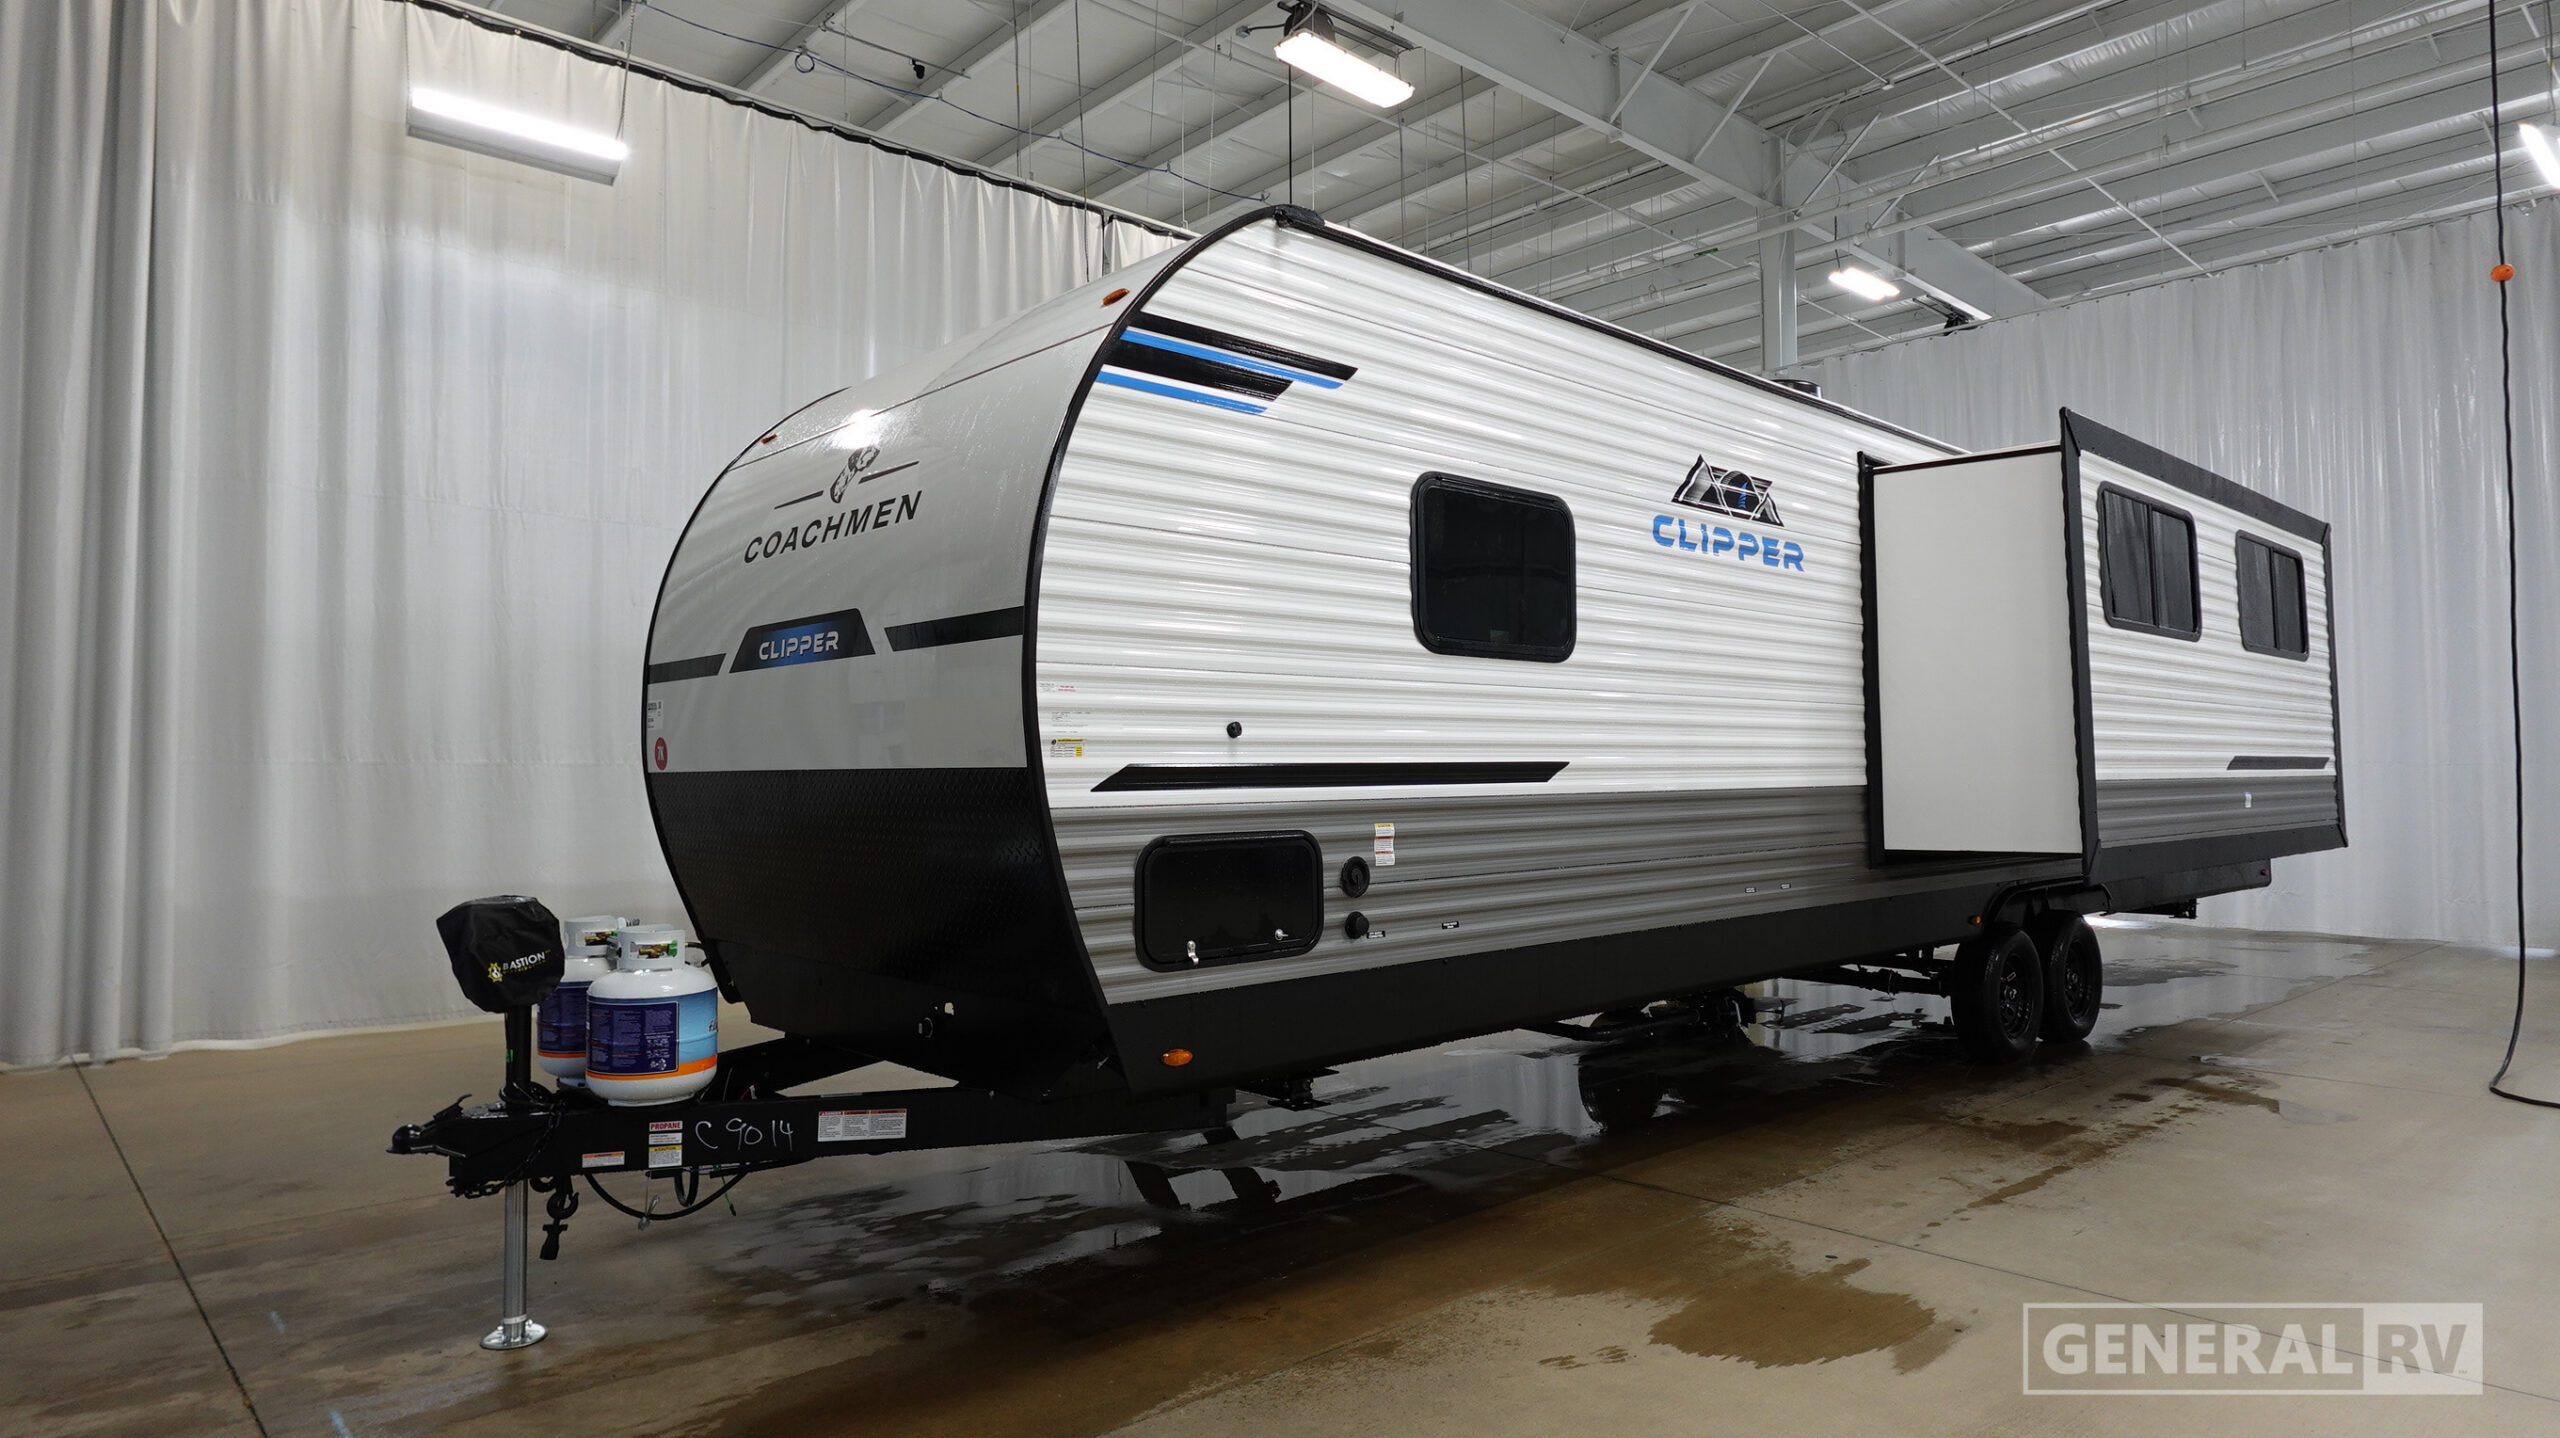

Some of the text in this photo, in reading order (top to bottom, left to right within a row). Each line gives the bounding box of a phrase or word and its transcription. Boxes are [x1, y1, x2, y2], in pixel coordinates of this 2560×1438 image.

[744, 490, 922, 563] COACHMEN
[1652, 514, 1805, 572] CLIPPER
[758, 630, 839, 661] CLIPPER
[502, 951, 546, 970] BASTION
[650, 1122, 681, 1130] PROPANE
